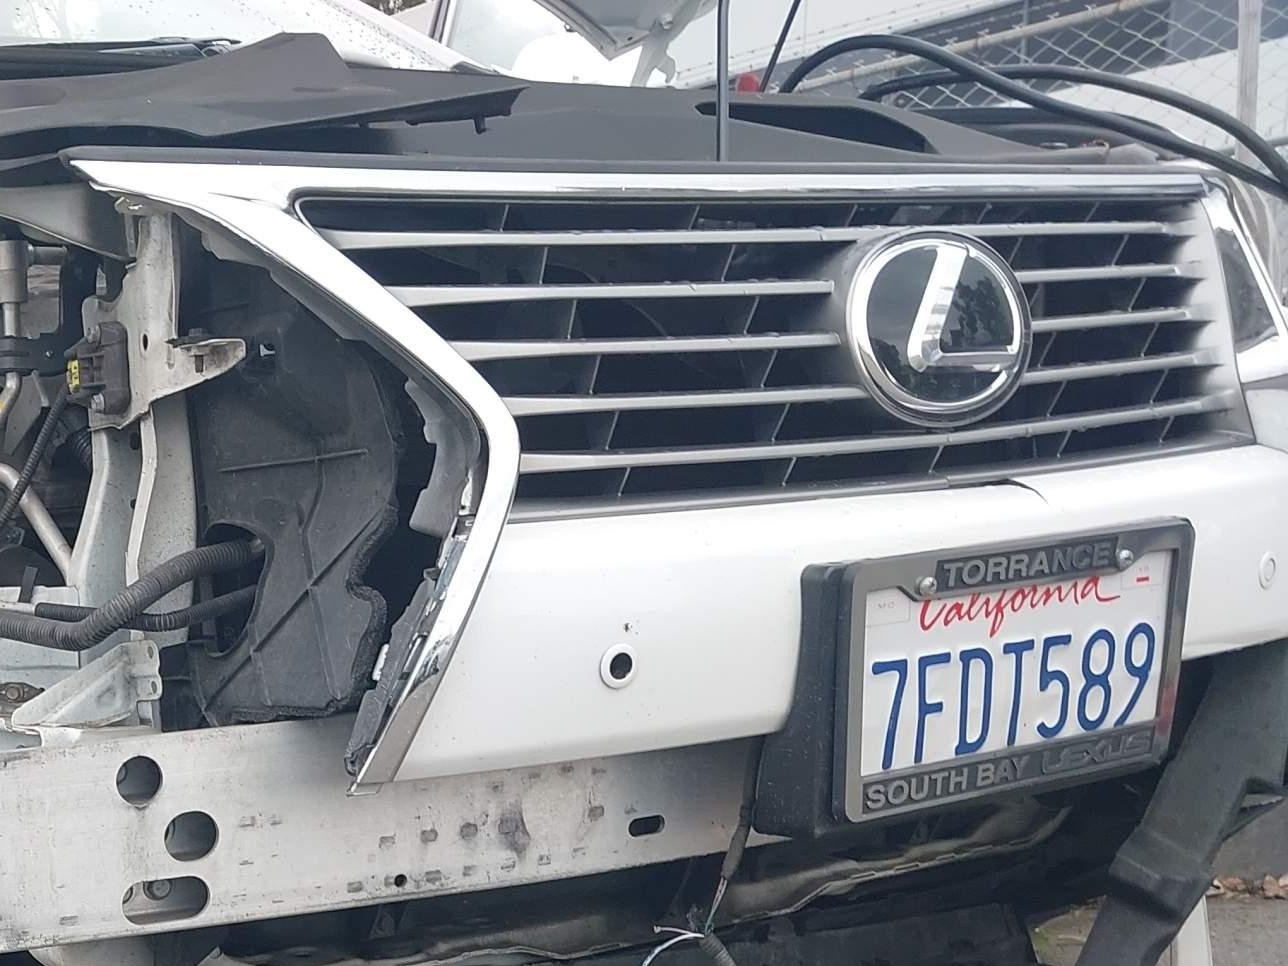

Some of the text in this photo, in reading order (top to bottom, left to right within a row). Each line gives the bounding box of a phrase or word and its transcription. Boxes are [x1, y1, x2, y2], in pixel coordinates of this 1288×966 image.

[943, 541, 1113, 588] TORRANCE
[920, 575, 1121, 638] California
[871, 622, 1155, 770] 7FDT589
[865, 733, 1152, 810] SOUTH BAY LEXUS
